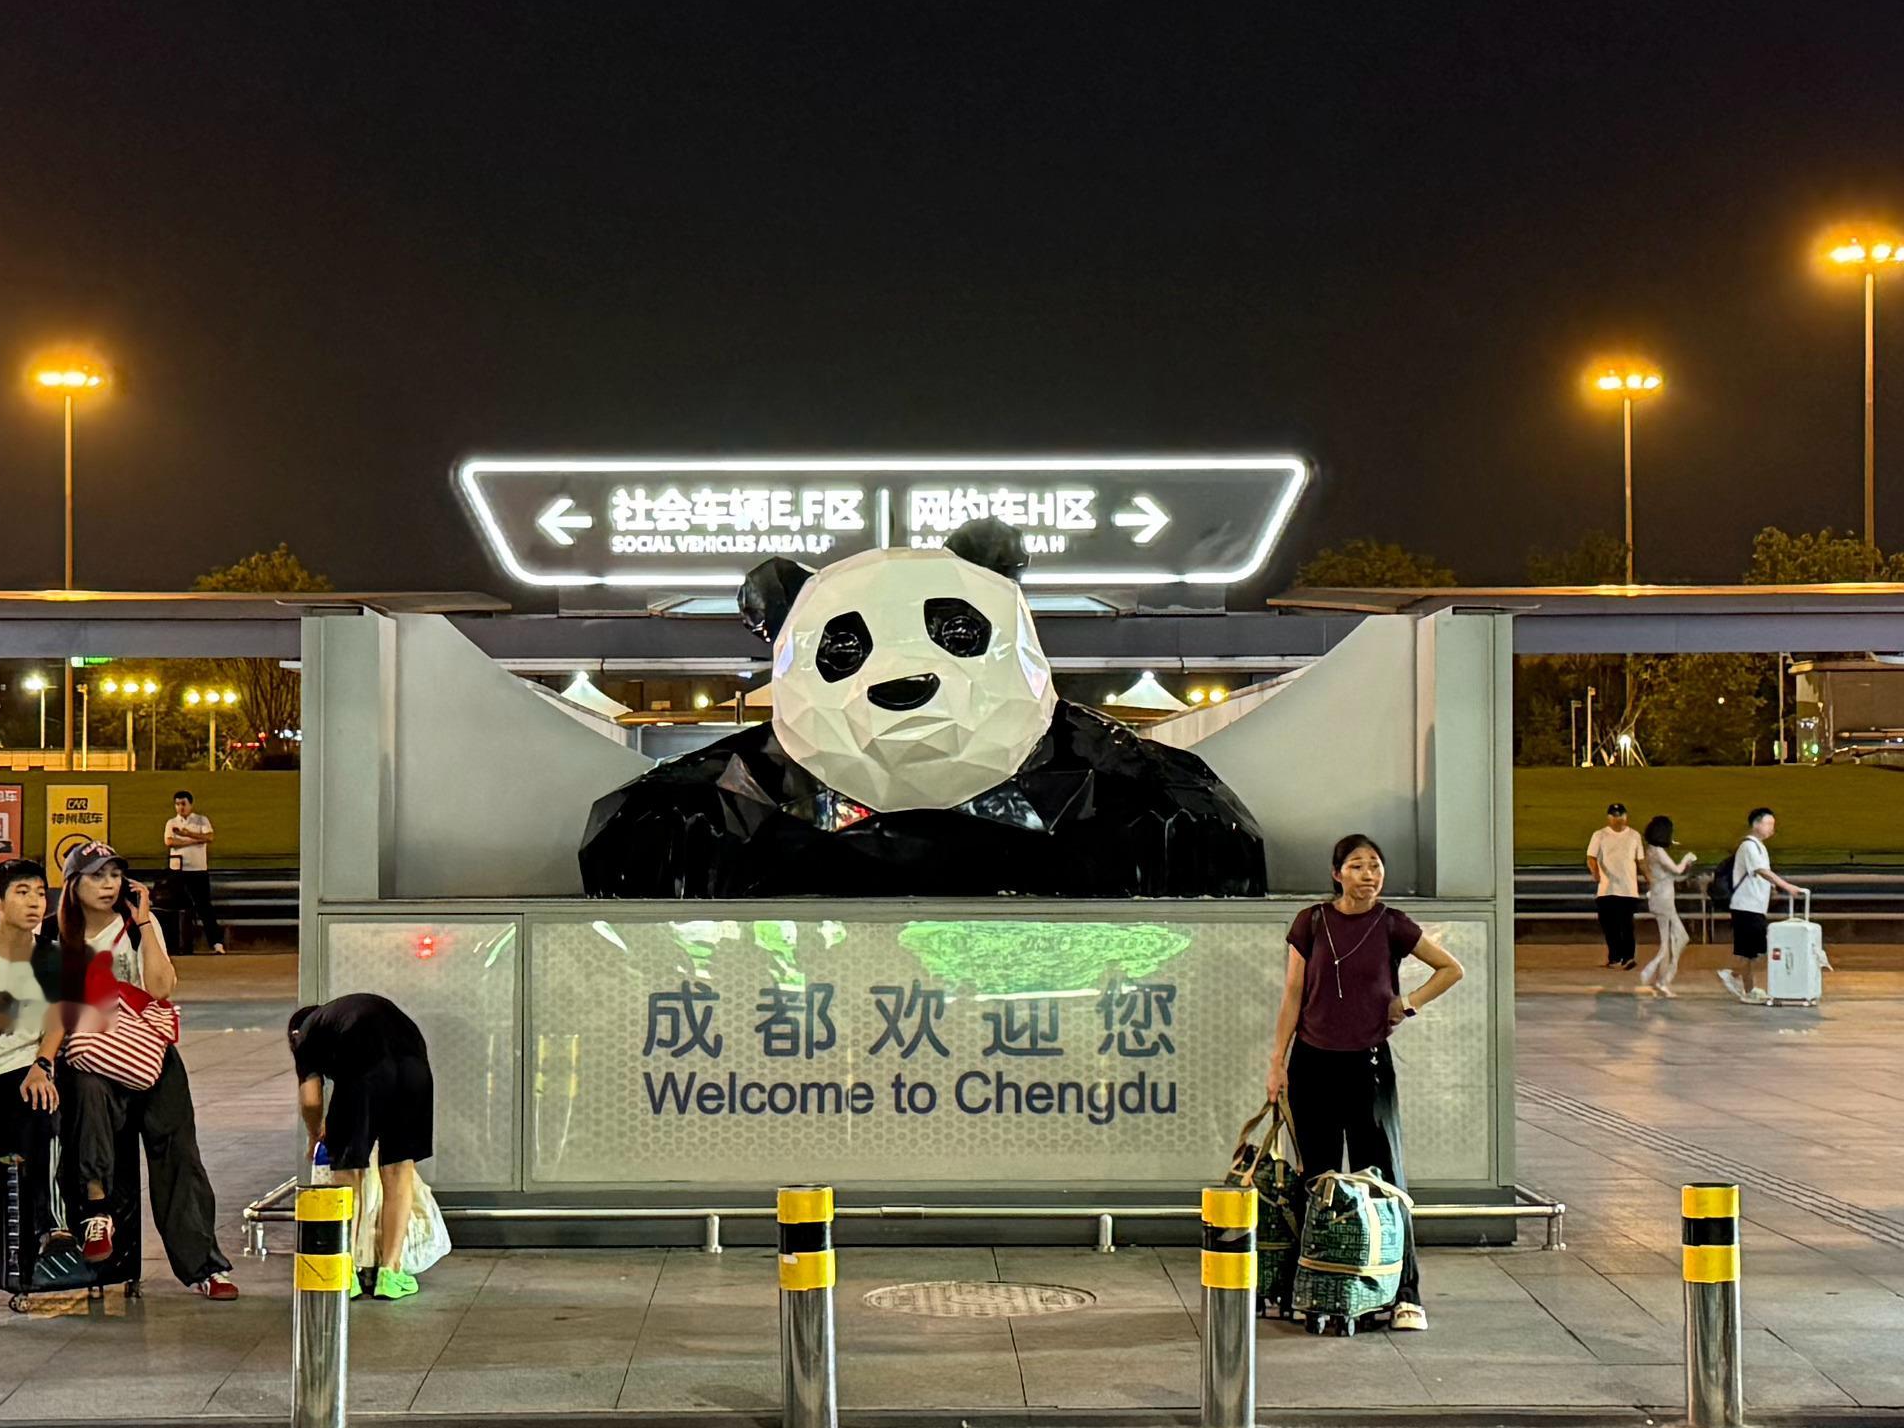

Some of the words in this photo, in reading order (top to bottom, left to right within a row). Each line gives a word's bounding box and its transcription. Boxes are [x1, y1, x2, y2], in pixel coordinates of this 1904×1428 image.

[611, 535, 675, 553] SOCIAL
[675, 535, 757, 553] VEHICLES
[757, 535, 805, 553] AREA
[642, 979, 1178, 1060] 成都欢迎您
[643, 1071, 875, 1116] Welcome
[890, 1073, 938, 1116] to
[953, 1071, 1178, 1126] Chengdu
